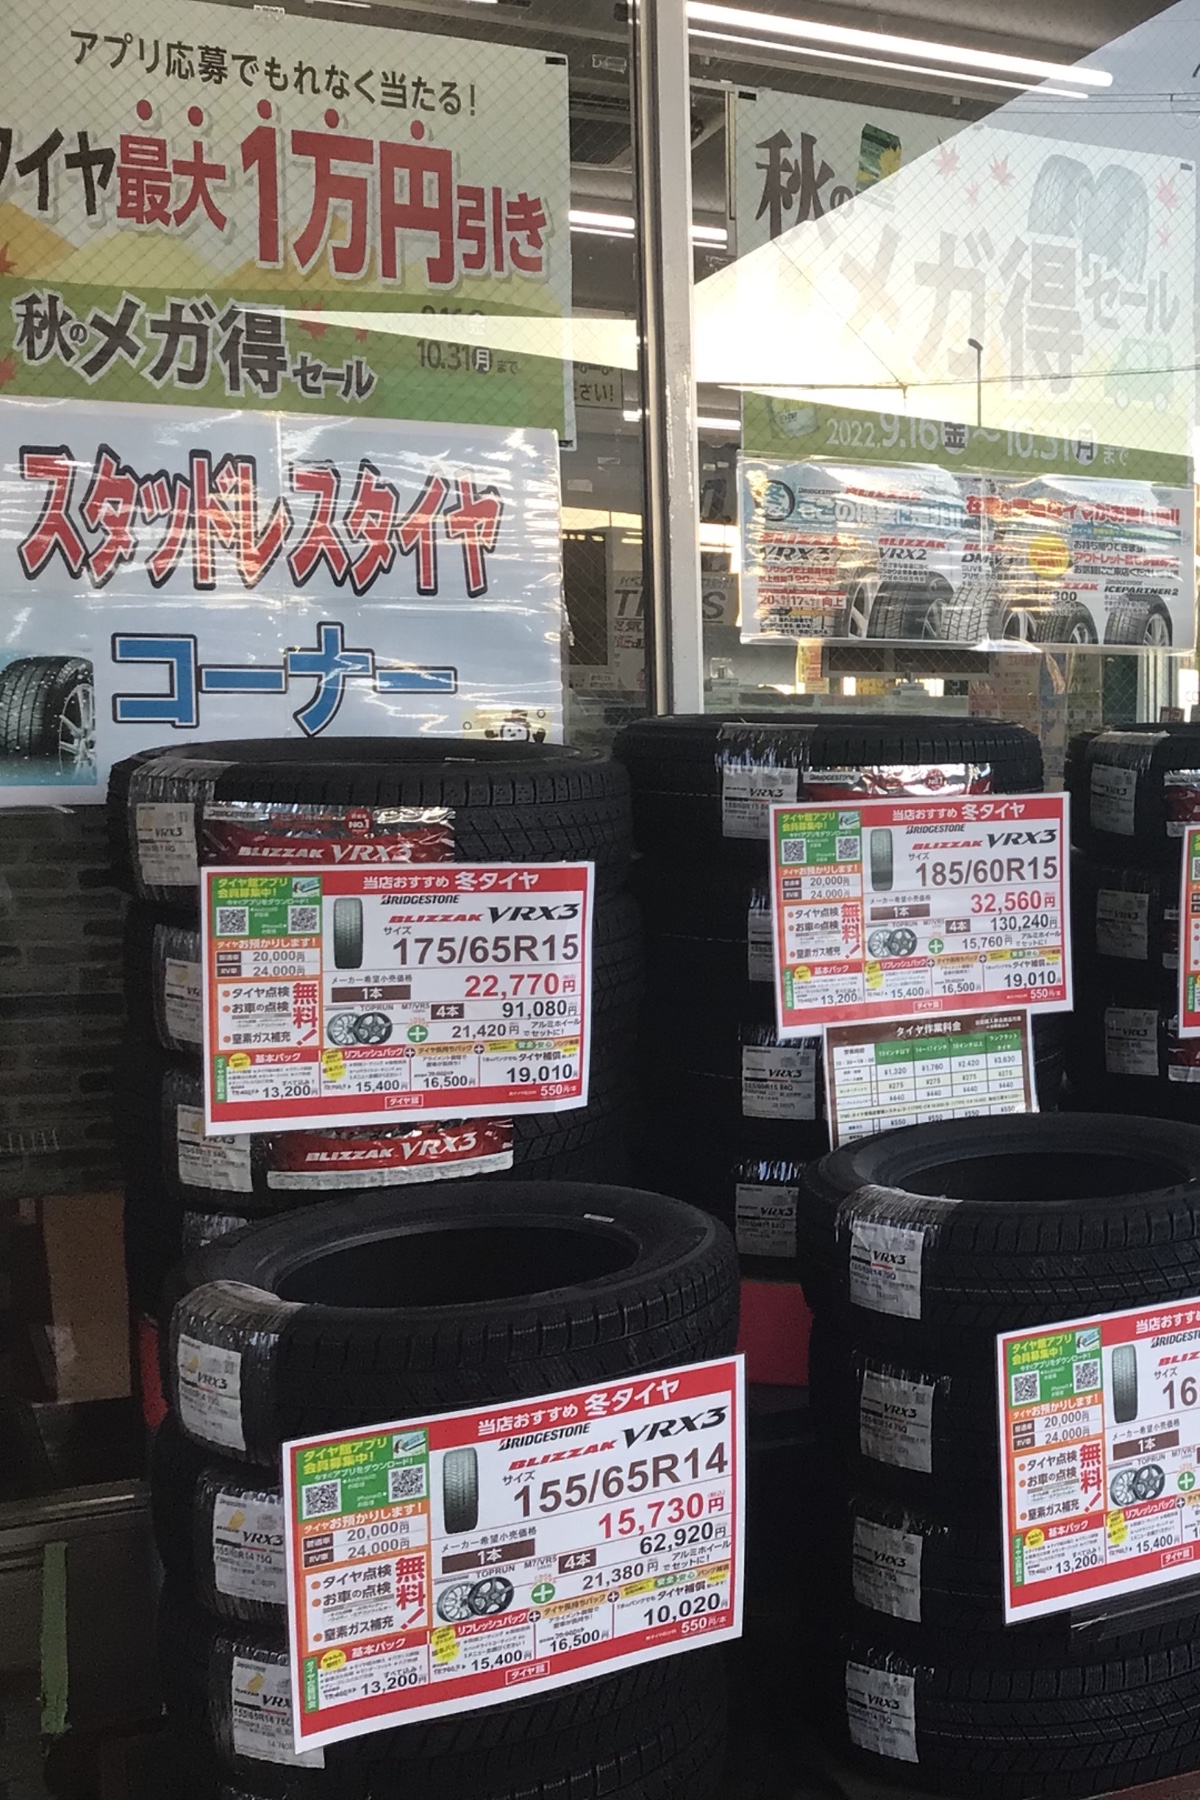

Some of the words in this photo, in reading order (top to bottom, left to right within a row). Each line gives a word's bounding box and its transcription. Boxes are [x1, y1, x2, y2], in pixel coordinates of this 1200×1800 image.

[19, 445, 501, 598] スタッドレスタイヤ
[878, 537, 947, 548] BLIZZAK
[878, 549, 927, 561] VRX2
[1104, 586, 1179, 595] ICEPARTNER2
[112, 622, 457, 738] コーナー
[893, 808, 958, 821] 当店おすすめ
[961, 803, 1025, 819] 冬タイヤ
[906, 824, 965, 834] BRIDGESTONE
[912, 840, 983, 850] BLIZZAK
[987, 829, 1057, 848] VRX3
[238, 846, 324, 859] BLIZZAK
[331, 844, 414, 863] VRX3
[915, 856, 1058, 887] 185/60R15
[363, 875, 449, 889] 当店おすすめ
[454, 872, 538, 890] 冬タイヤ
[381, 895, 460, 905] BRIDGESTONE
[389, 914, 483, 923] BLIZZAK
[488, 904, 580, 923] VRX3
[384, 926, 412, 935] サイズ
[393, 934, 578, 965] 175/65R15
[332, 974, 412, 985] メーカー希望小売価格
[306, 1148, 394, 1162] BLIZZAK
[401, 1132, 477, 1161] VRX3
[873, 1250, 906, 1265] VRX3
[197, 1372, 228, 1390] VRX3
[477, 1403, 579, 1436] 当店おすすめ
[584, 1378, 680, 1416] 冬タイヤ
[498, 1423, 591, 1452] BRIDGESTONE
[508, 1439, 618, 1471] BLIZZAK
[622, 1406, 729, 1449] VRX3
[502, 1470, 536, 1485] サイズ
[514, 1442, 729, 1518] 155/65R14
[242, 1531, 284, 1546] VRX3
[442, 1526, 537, 1551] メーカー希望小売価格
[478, 1548, 502, 1565] 1本
[563, 1552, 590, 1570] 4本
[324, 1614, 394, 1642] 窒素ガス補充
[351, 1638, 405, 1657] 基本パック
[868, 1694, 900, 1710] VRX3
